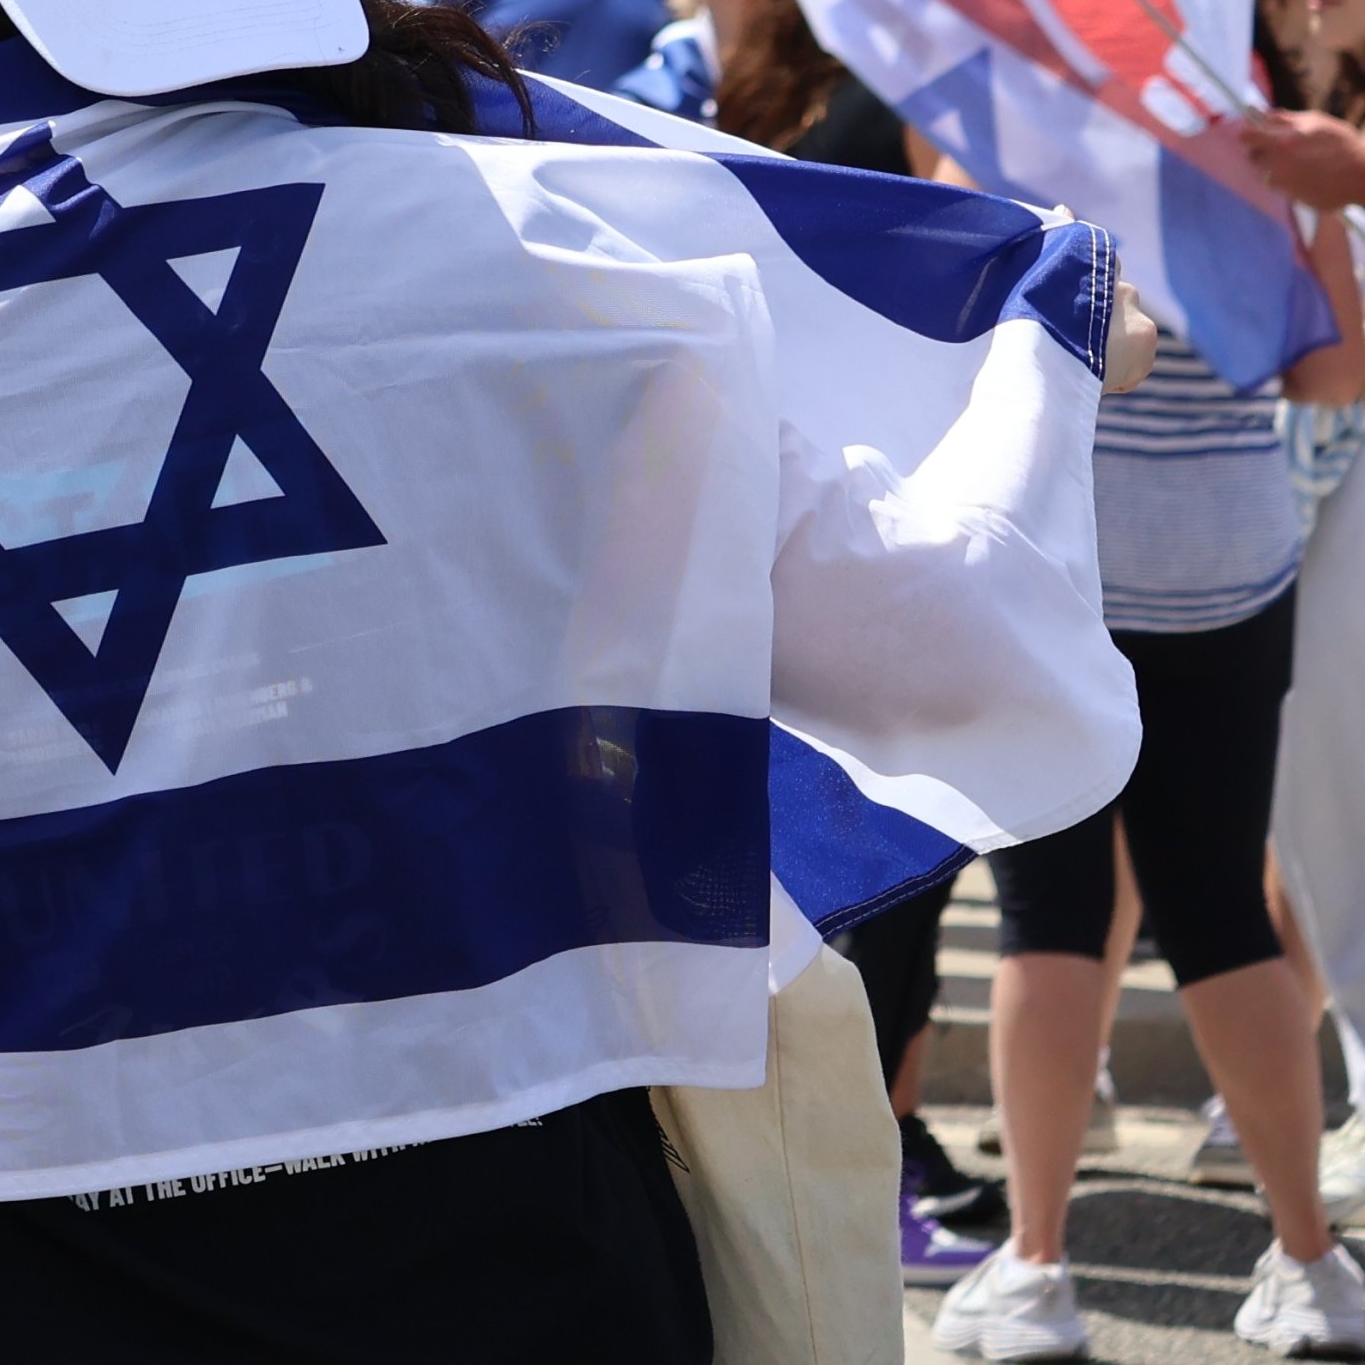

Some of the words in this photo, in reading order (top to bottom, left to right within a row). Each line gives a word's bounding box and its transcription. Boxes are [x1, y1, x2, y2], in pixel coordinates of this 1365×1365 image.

[69, 1189, 100, 1212] AY
[110, 1186, 135, 1208] AT
[145, 1180, 187, 1202] THE
